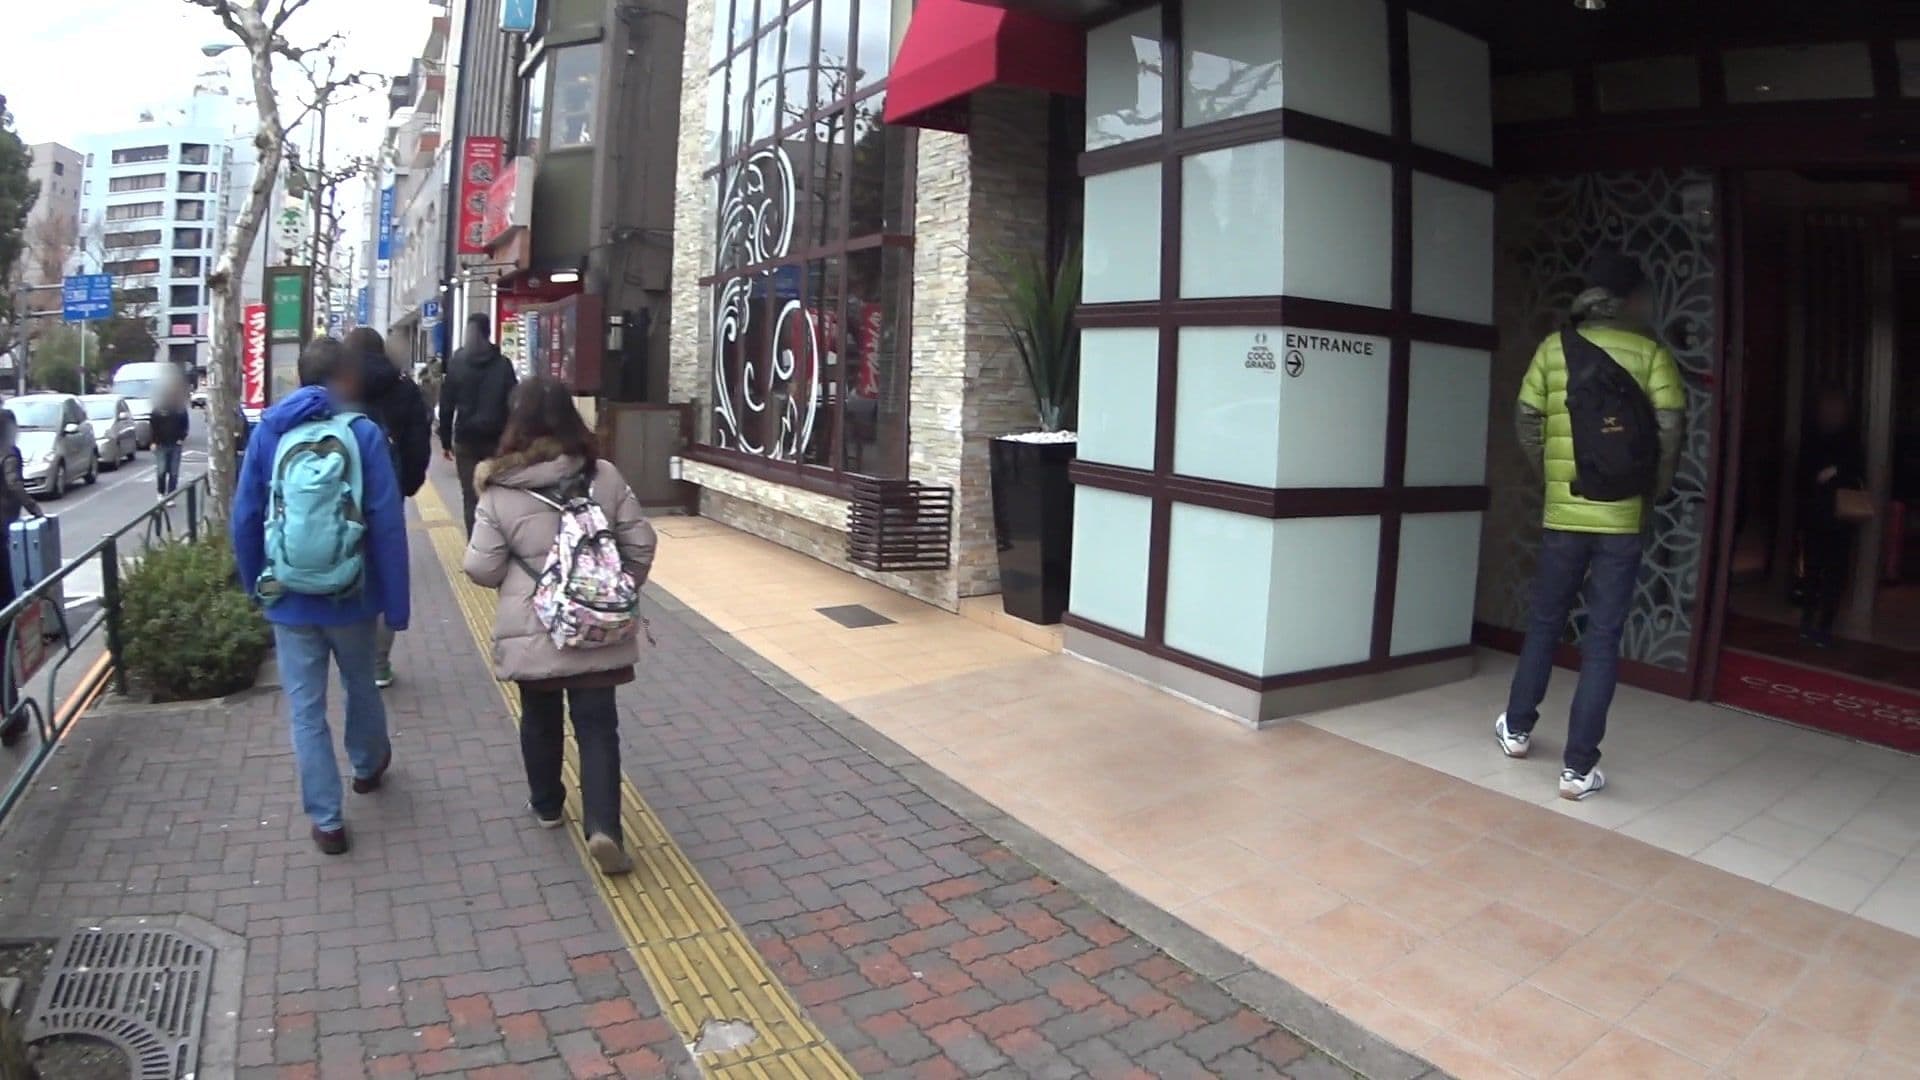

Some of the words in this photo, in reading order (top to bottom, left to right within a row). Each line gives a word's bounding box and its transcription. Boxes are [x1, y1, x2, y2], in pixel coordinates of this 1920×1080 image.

[1286, 333, 1373, 356] ENTRANCE
[1247, 352, 1274, 361] COCO
[1245, 361, 1276, 370] GRAND
